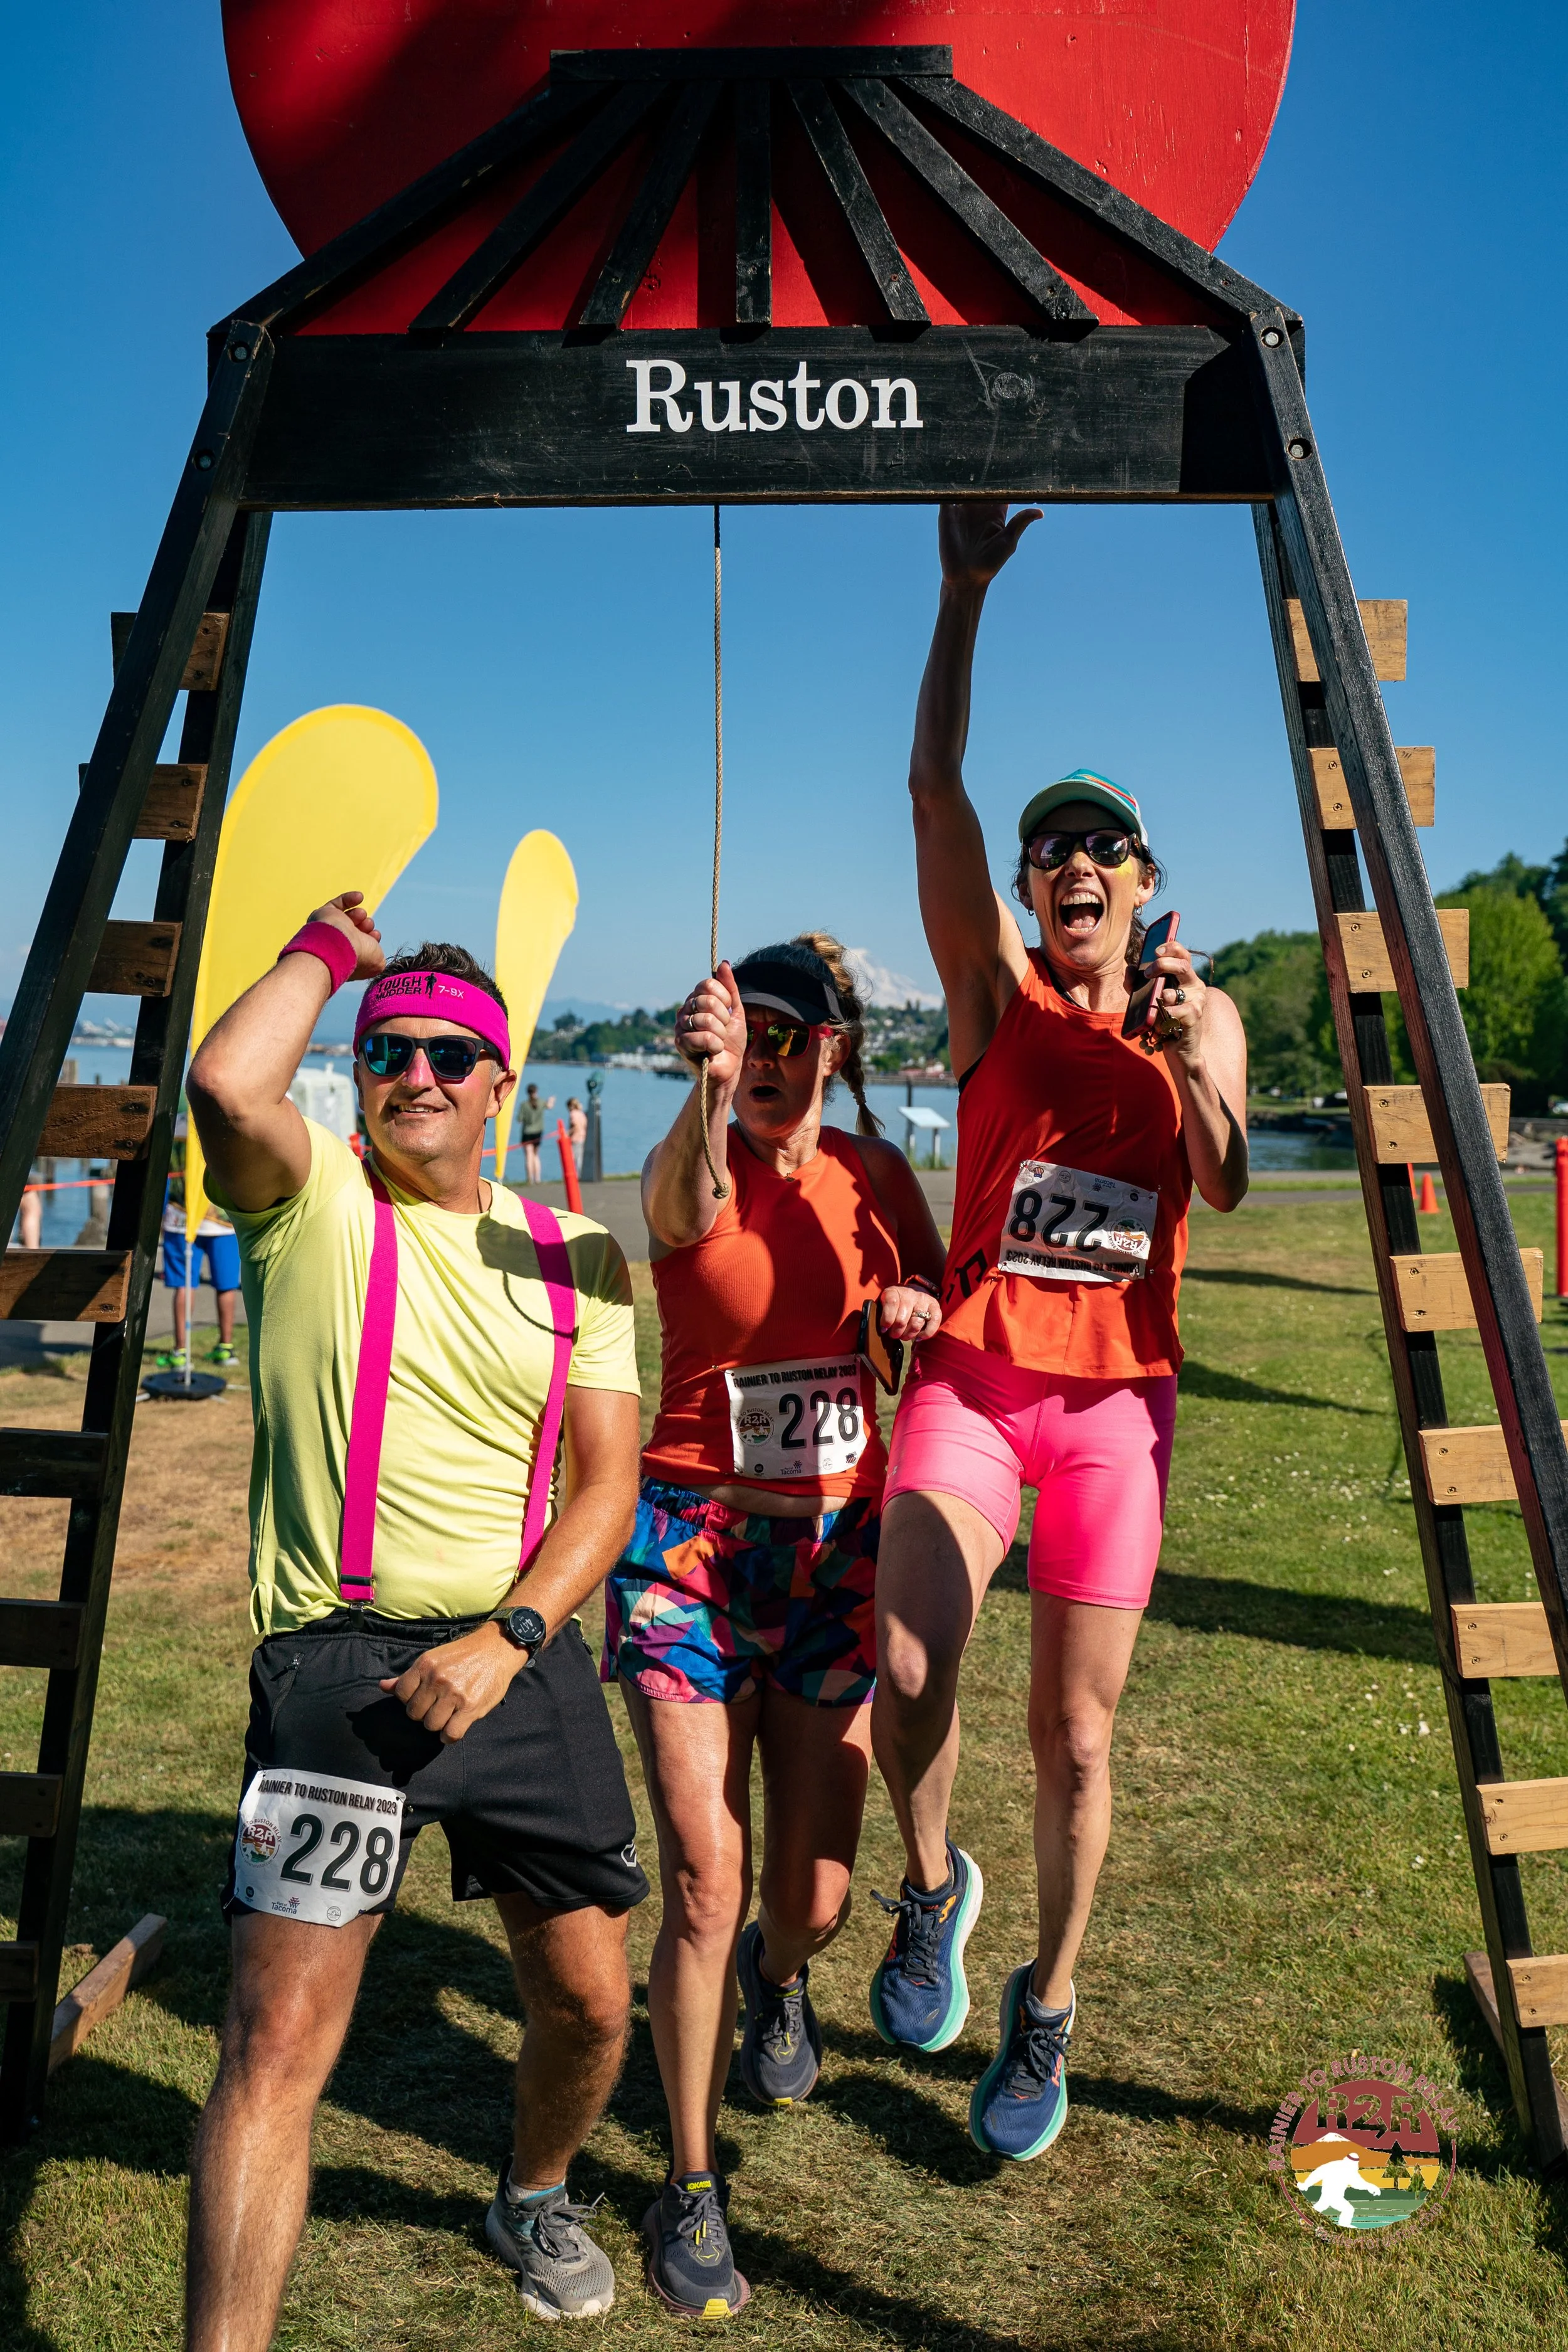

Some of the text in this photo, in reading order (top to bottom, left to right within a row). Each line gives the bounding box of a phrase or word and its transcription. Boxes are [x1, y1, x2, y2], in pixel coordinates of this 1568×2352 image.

[626, 359, 923, 433] Ruston
[378, 975, 422, 992] TOUGH
[376, 987, 422, 1001] MUDDER
[438, 985, 464, 999] 7-9X
[1094, 1177, 1116, 1188] Tacoma
[1009, 1189, 1110, 1253] 228
[1116, 1236, 1138, 1249] R2R
[1007, 1250, 1030, 1264] 2023
[1031, 1254, 1057, 1268] RELAY
[1059, 1258, 1092, 1271] RUSTON
[1092, 1261, 1104, 1271] TO
[733, 1364, 857, 1388] RAINIER TO RUSTON RELAY 2023
[744, 1416, 766, 1425] R2R
[778, 1387, 859, 1450] 228
[258, 1779, 398, 1814] RAINIER TO RUSTON RELAY 2023
[247, 1825, 274, 1841] R2R
[254, 1818, 273, 1828] RUSTON
[273, 1826, 282, 1843] RELAY
[280, 1813, 395, 1896] 228
[272, 1902, 297, 1914] Tacoma
